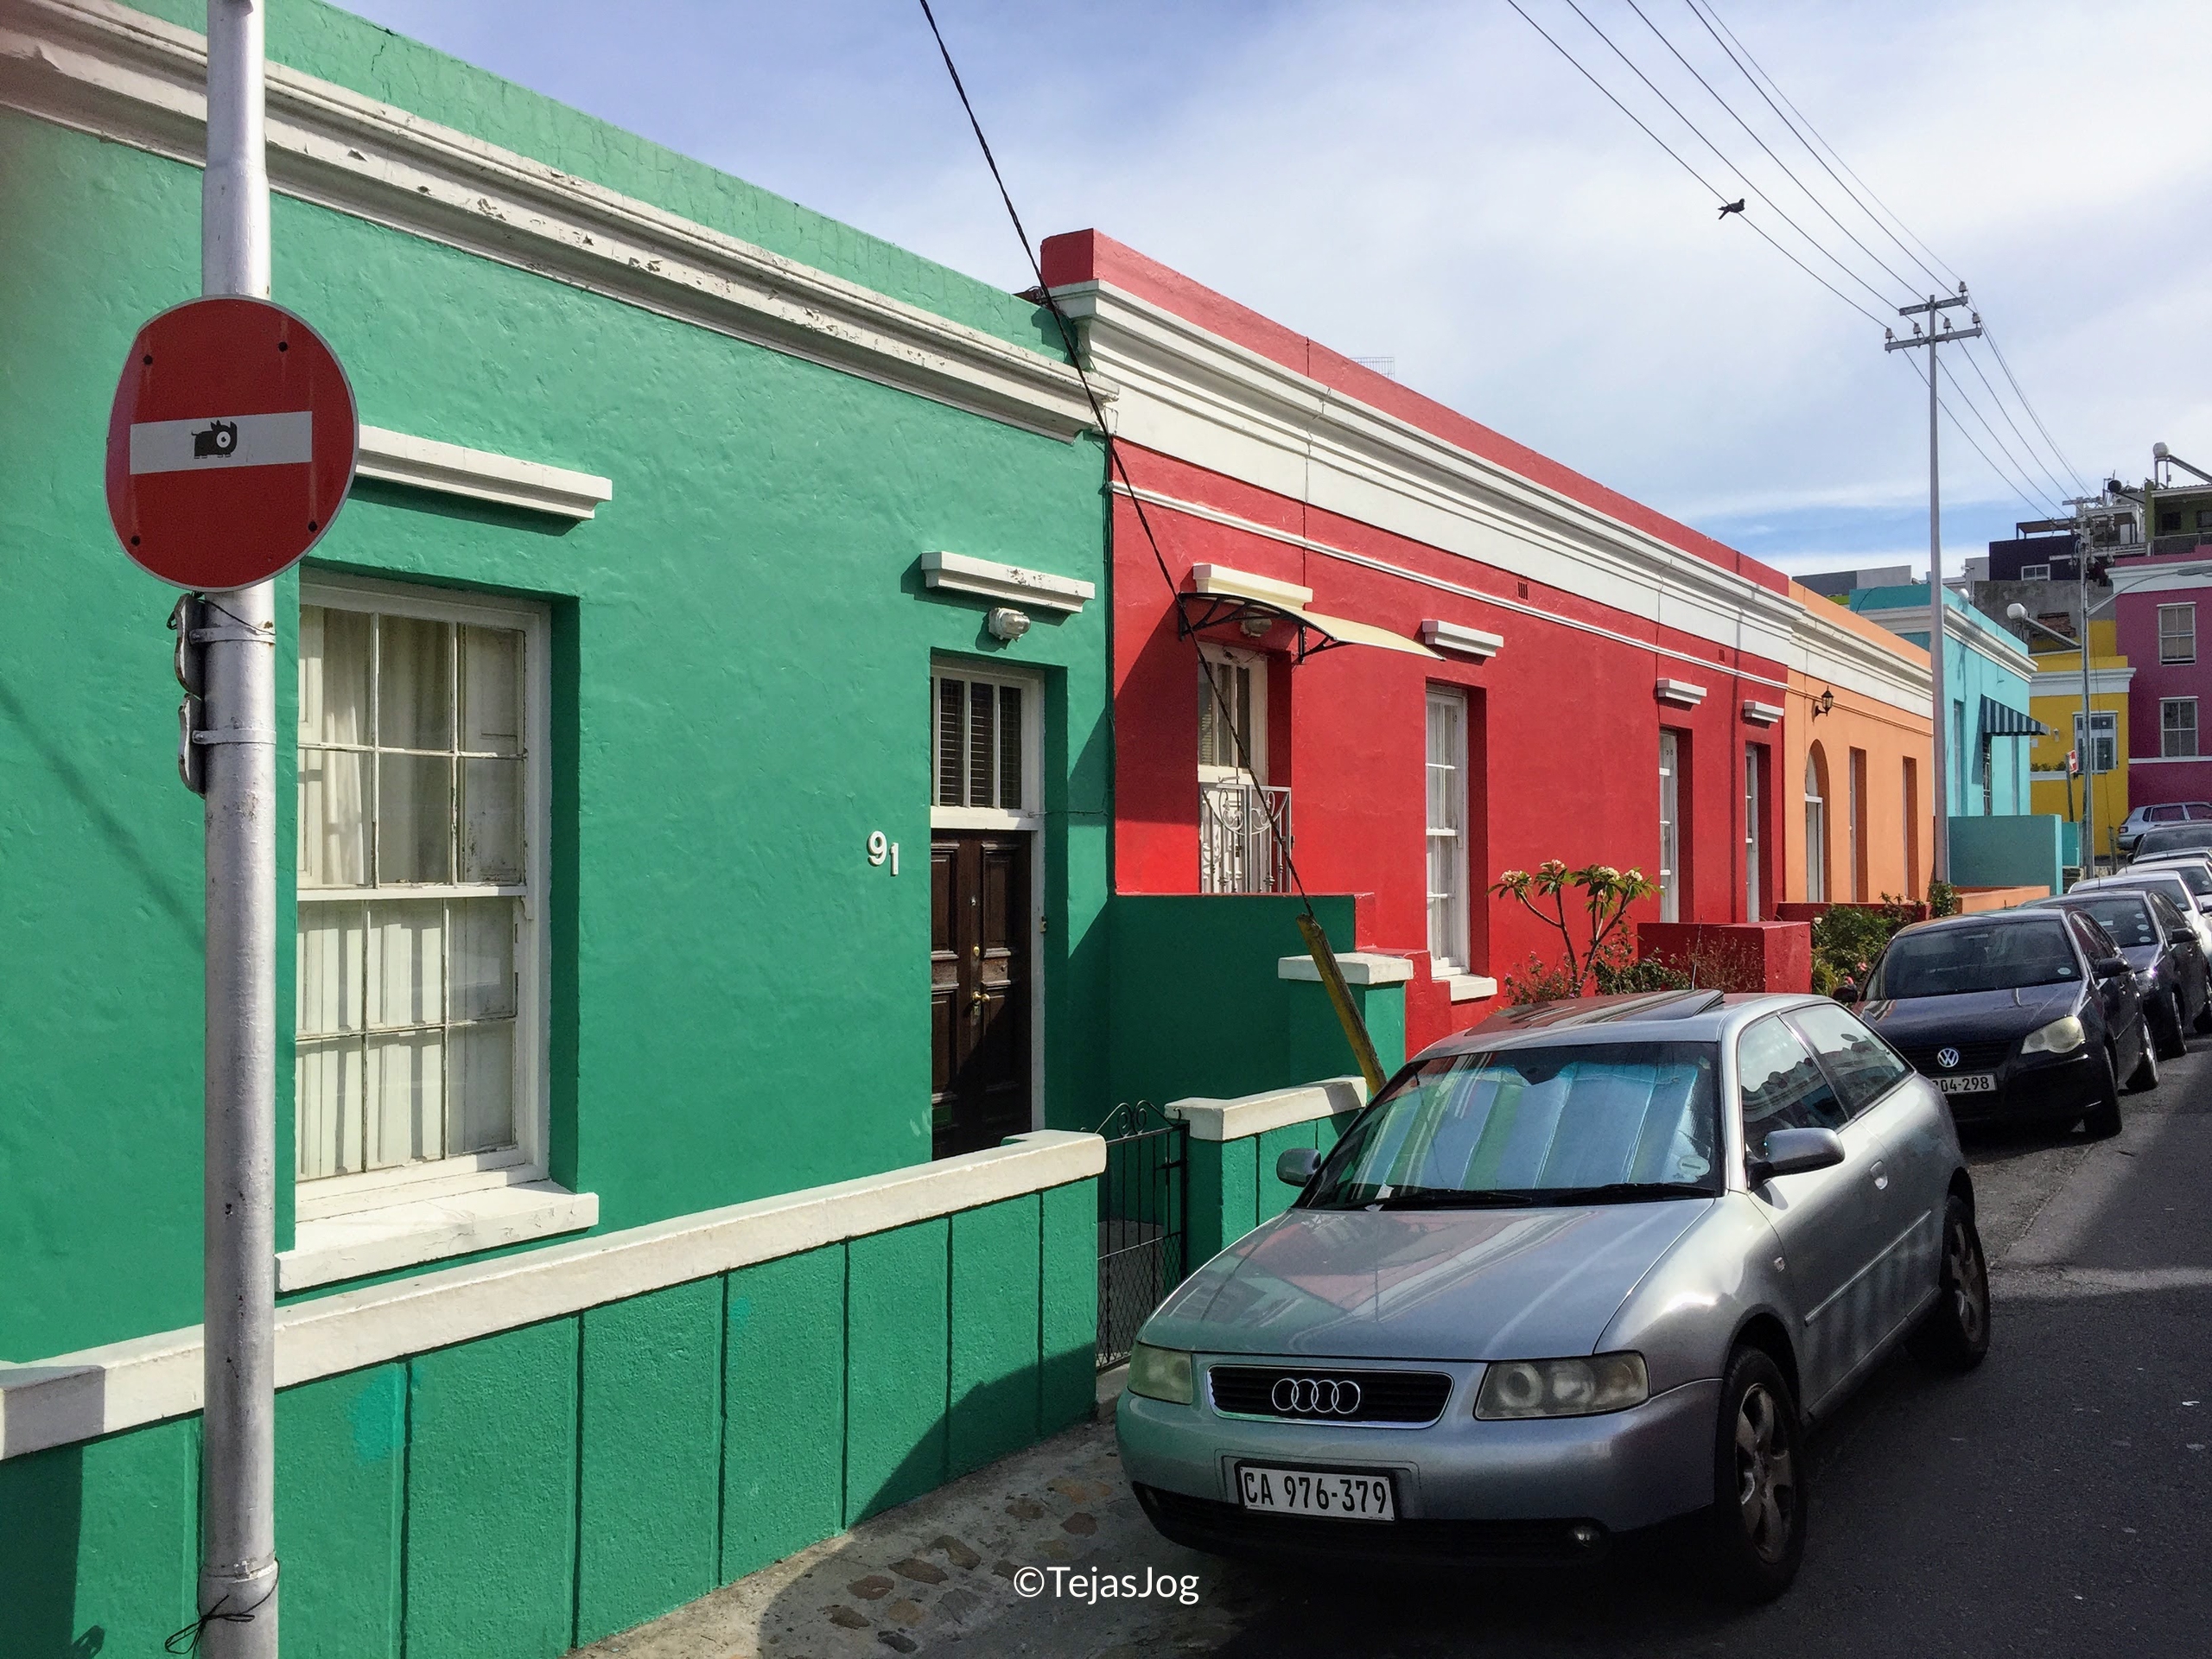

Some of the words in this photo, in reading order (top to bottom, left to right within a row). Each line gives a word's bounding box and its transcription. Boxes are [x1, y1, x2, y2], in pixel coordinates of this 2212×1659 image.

[868, 830, 899, 874] 91
[1932, 1077, 1989, 1092] 04-298
[1244, 1471, 1274, 1506] CA
[1284, 1475, 1386, 1514] 976-379
